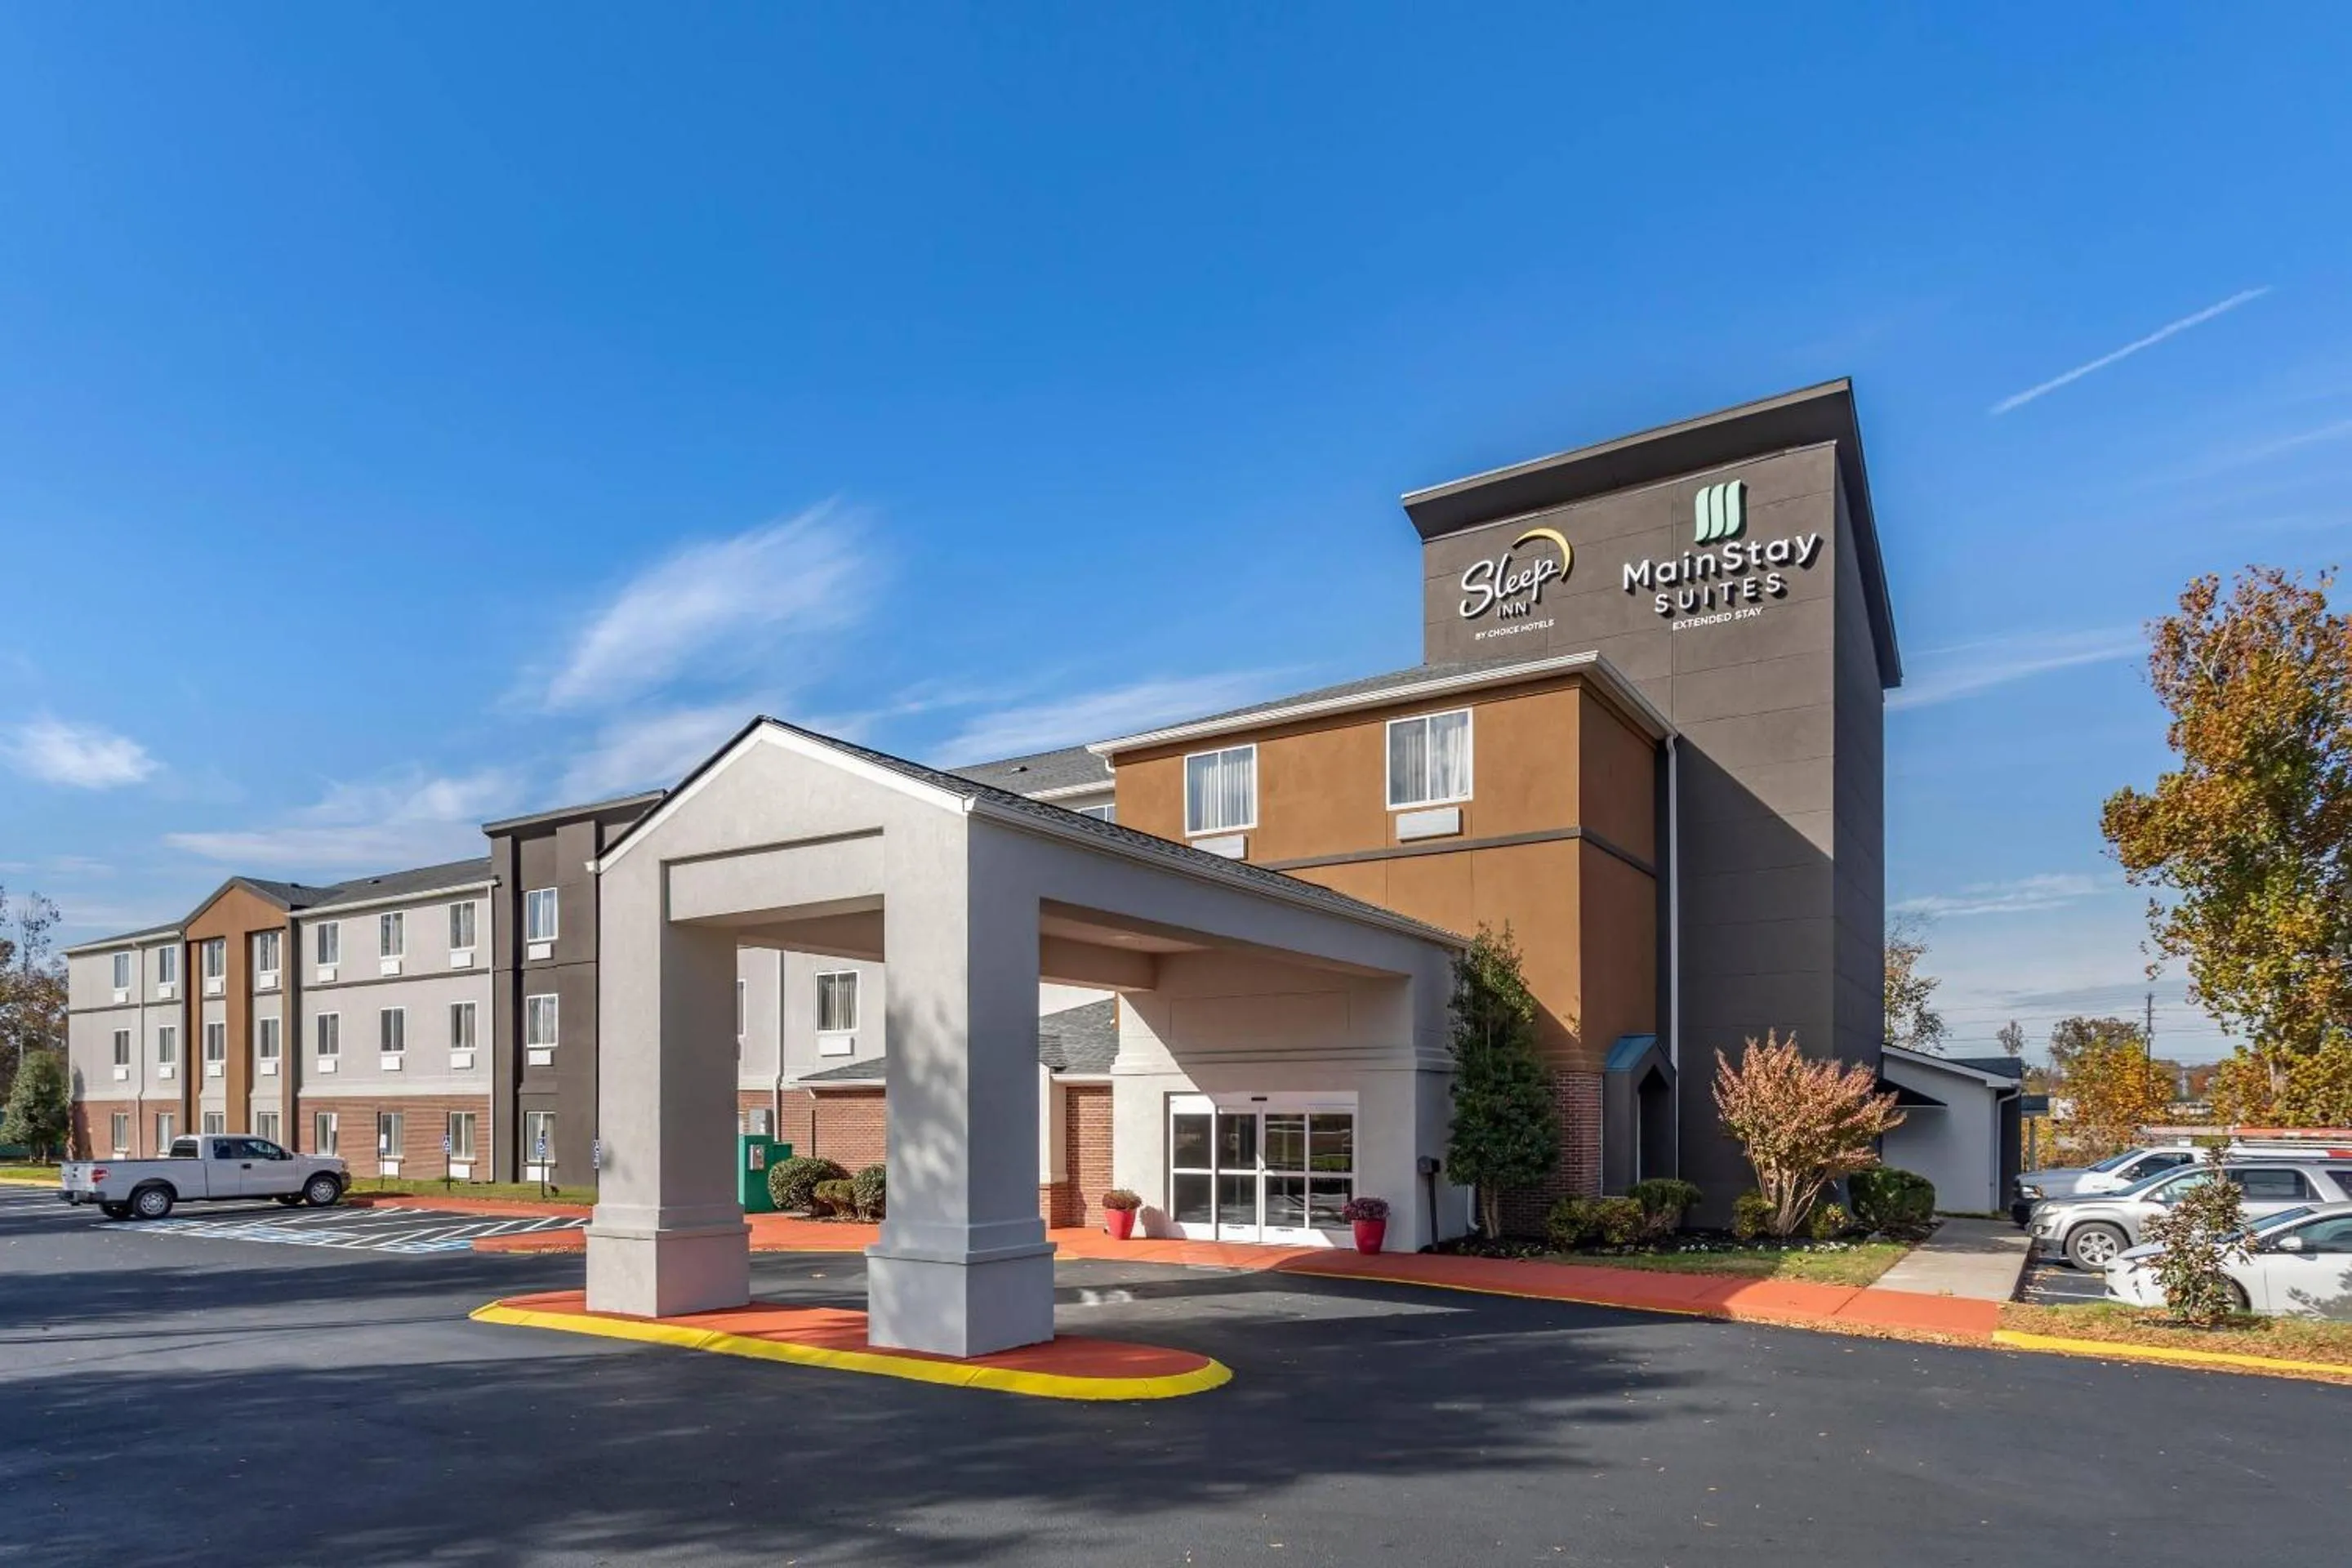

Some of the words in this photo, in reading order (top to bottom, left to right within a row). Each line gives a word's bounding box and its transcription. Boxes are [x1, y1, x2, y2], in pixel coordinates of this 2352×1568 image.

[1623, 532, 1817, 590] MainStay
[1459, 553, 1559, 617] Sleep
[1655, 572, 1782, 613] SUITES
[1497, 601, 1527, 618] INN
[1672, 612, 1733, 631] EXTENDED
[1735, 606, 1764, 621] STAY
[1475, 631, 1486, 640] BY
[1487, 625, 1520, 638] CHOICE
[1521, 619, 1555, 632] HOTELS
